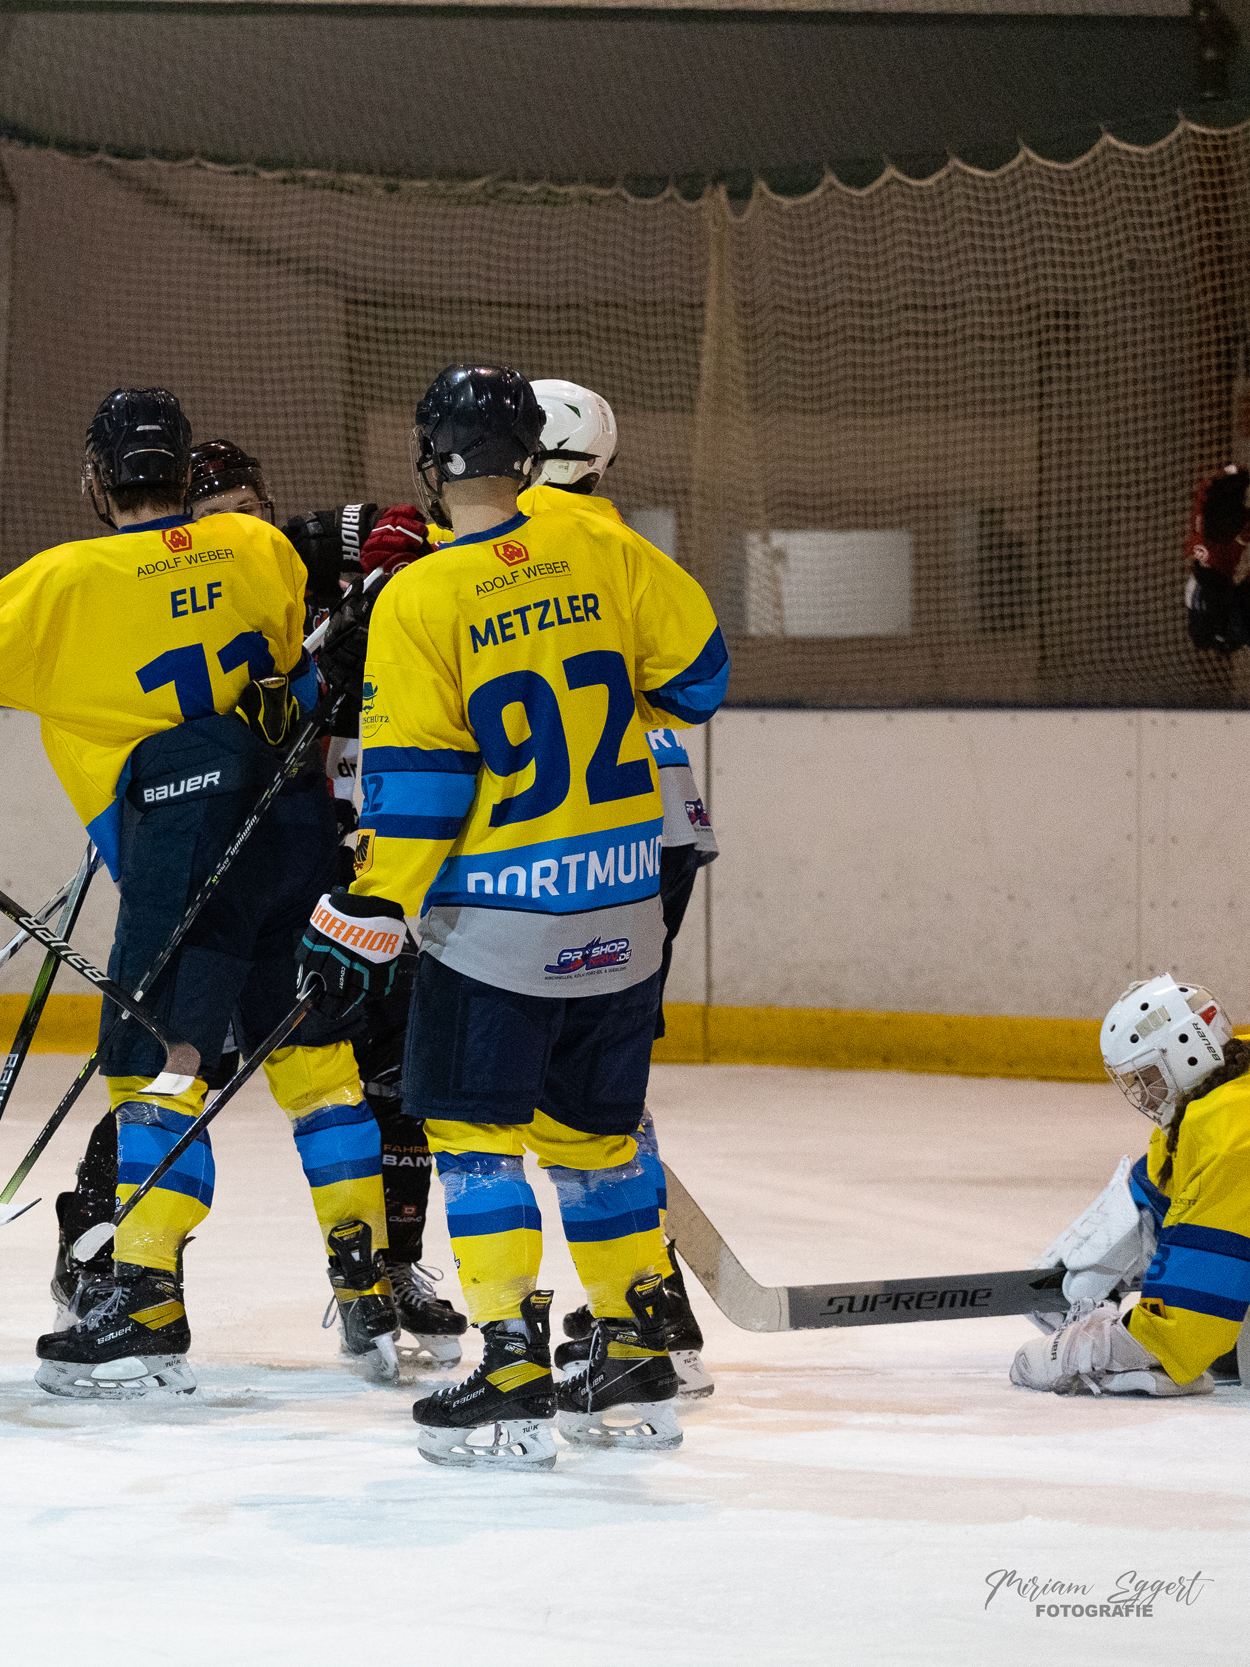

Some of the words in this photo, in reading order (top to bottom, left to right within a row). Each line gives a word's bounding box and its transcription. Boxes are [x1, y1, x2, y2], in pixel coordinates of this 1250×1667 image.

[137, 557, 182, 577] ADOLF
[185, 548, 235, 565] WEBER
[475, 570, 520, 596] ADOLF
[522, 560, 571, 579] WEBER
[170, 581, 222, 619] ELF
[469, 593, 602, 654] METZLER
[467, 649, 655, 828] 92
[143, 770, 221, 803] BAUER
[18, 915, 112, 983] BAUER
[338, 966, 346, 990] COVERT
[1192, 1022, 1221, 1061] BAUER
[819, 1288, 993, 1316] SUPREME
[96, 1325, 133, 1345] BAUER
